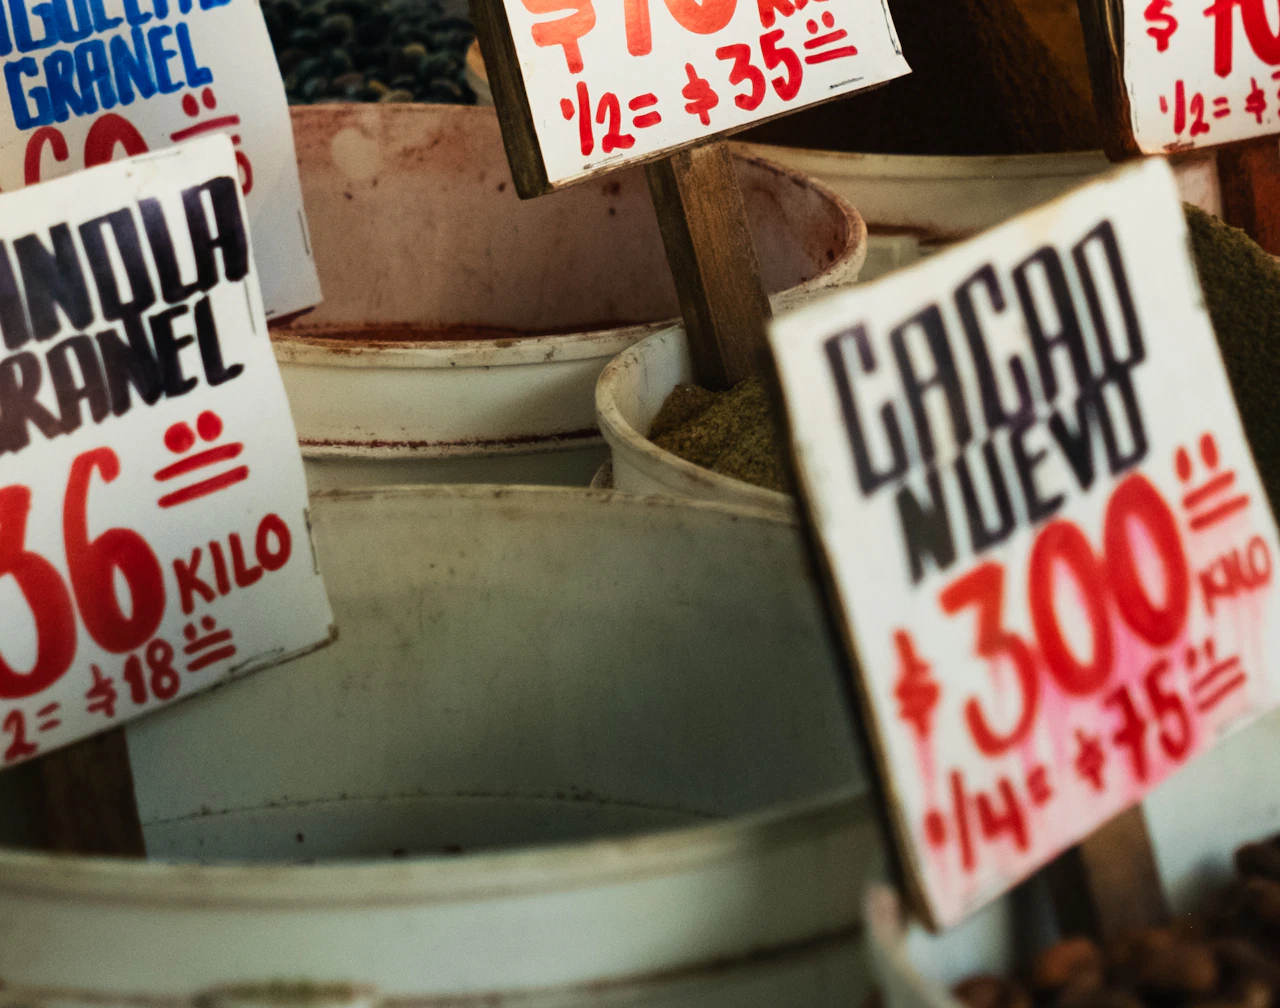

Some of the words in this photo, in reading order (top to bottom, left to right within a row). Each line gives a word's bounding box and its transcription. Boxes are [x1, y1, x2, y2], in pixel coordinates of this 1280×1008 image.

[4, 23, 213, 131] GRANEL
[823, 217, 1147, 498] CACAO
[173, 512, 293, 615] KILO
[896, 366, 1149, 586] NUEVO
[892, 472, 1190, 760] $300
[1196, 534, 1274, 622] KILO
